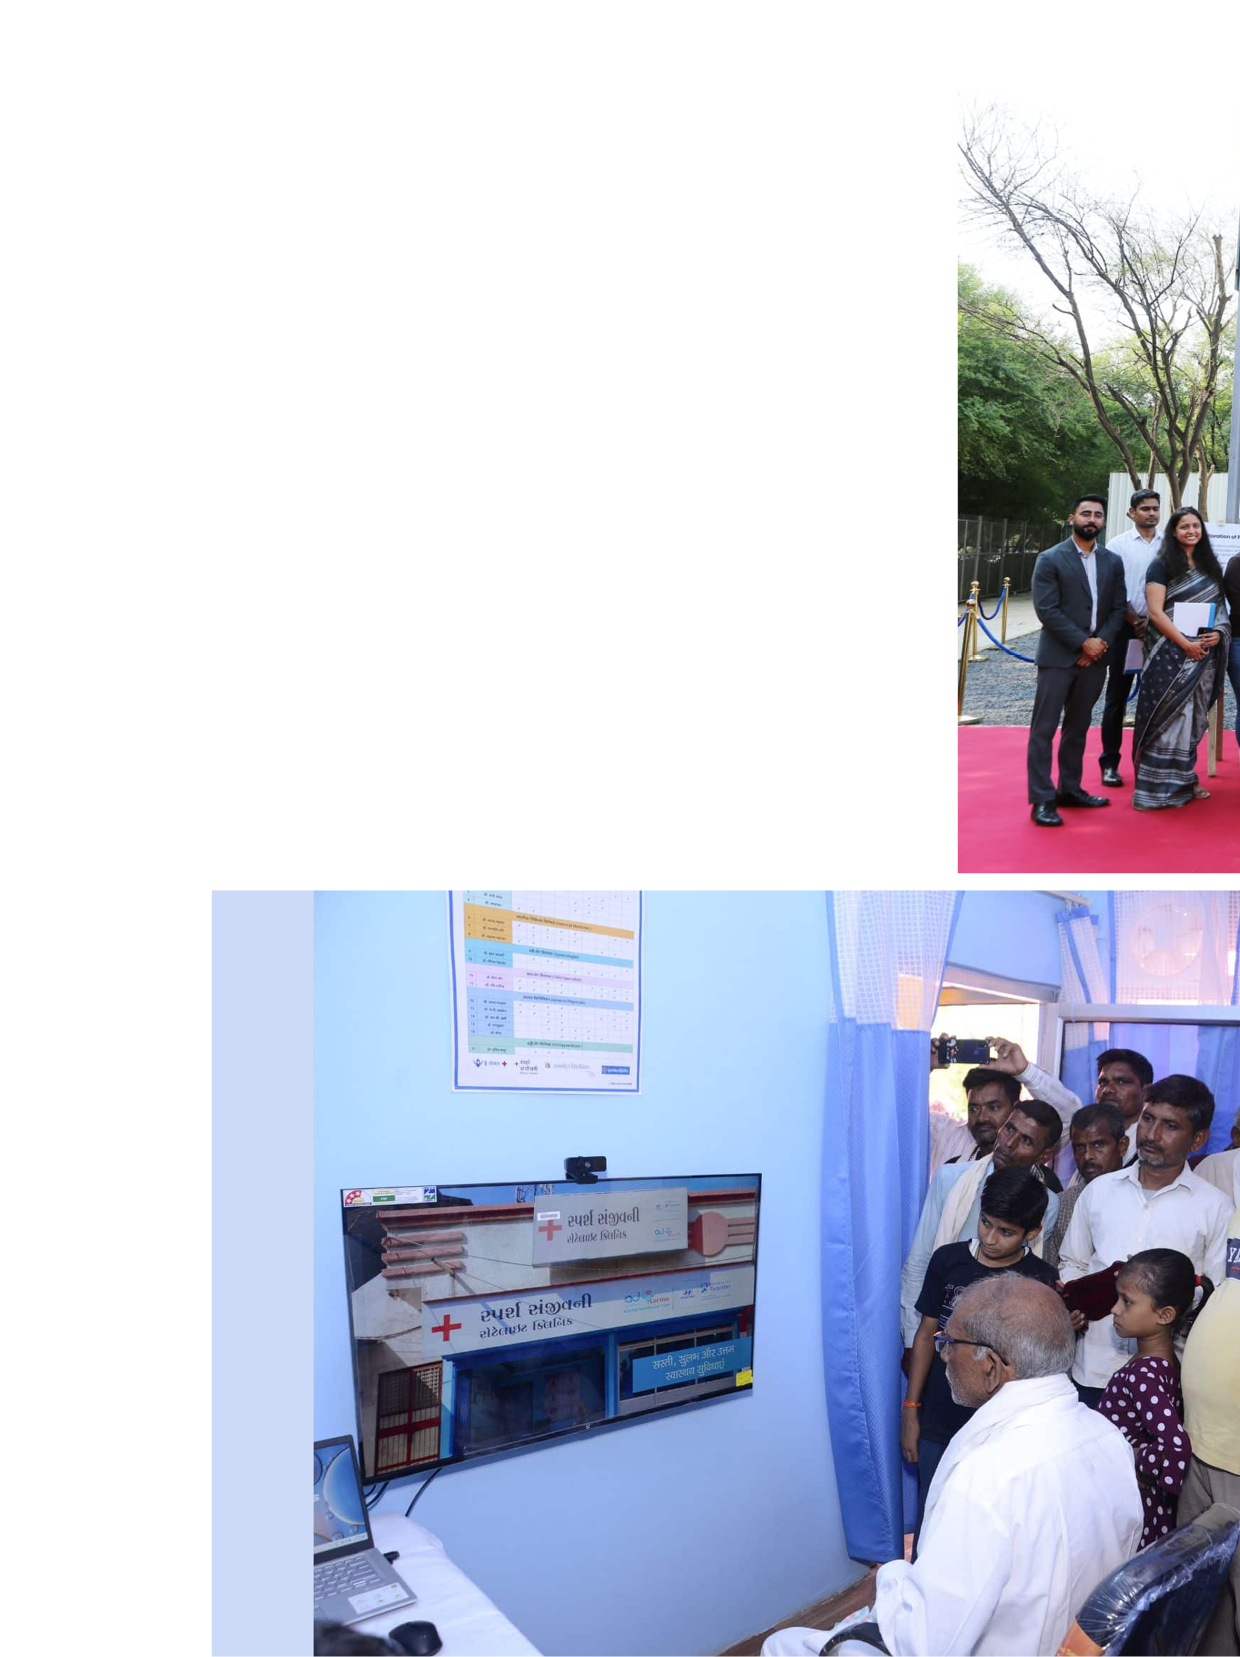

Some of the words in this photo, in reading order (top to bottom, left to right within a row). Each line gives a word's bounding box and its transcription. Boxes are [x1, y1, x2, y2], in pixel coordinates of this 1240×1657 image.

[480, 1301, 522, 1322] સ્પર્શ
[529, 1292, 593, 1316] સંજીવની
[652, 1355, 676, 1370] सस्ती,
[678, 1352, 700, 1367] सुलभ
[701, 1347, 716, 1359] और
[717, 1344, 735, 1356] उत्तम
